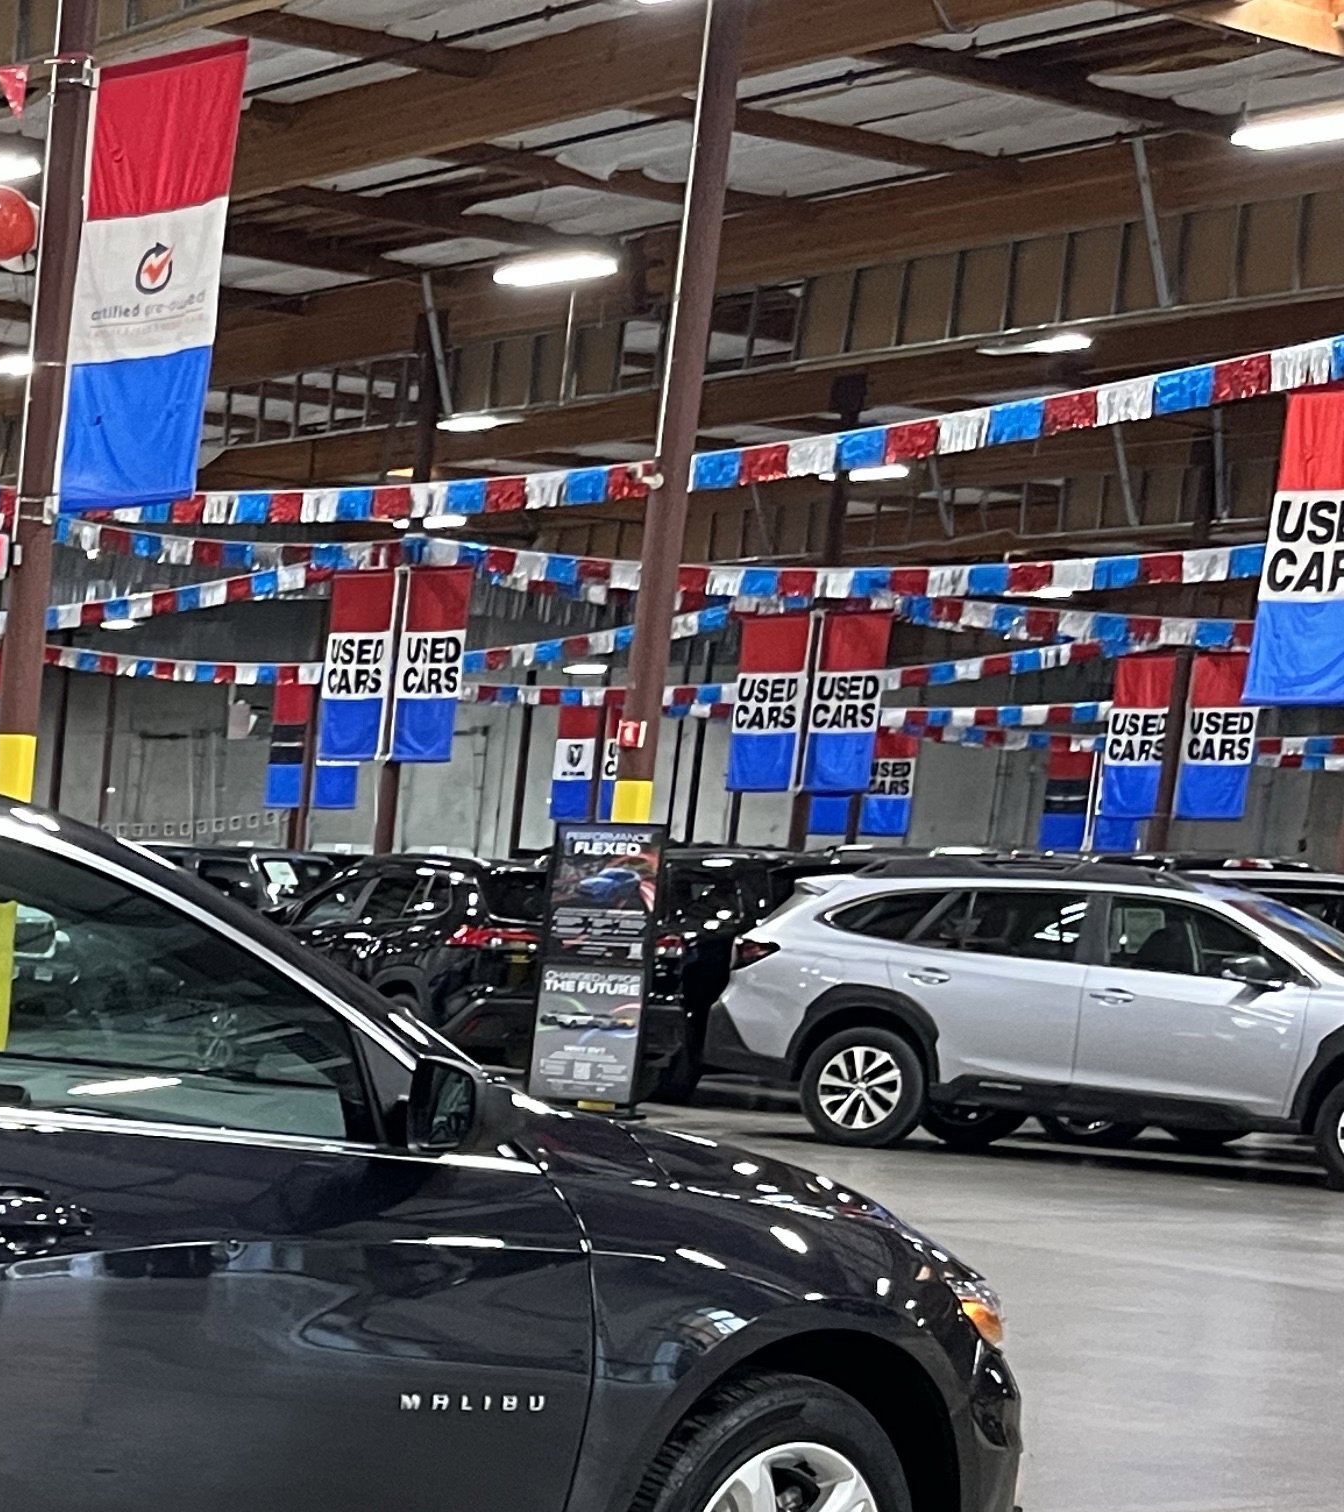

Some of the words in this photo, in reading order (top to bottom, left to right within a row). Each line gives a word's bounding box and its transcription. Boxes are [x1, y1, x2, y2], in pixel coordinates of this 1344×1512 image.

[1277, 501, 1344, 545] US
[1267, 548, 1344, 592] CA
[328, 667, 382, 694] CARS
[738, 678, 798, 703] USED
[817, 675, 879, 701] USED
[735, 704, 796, 729] CARS
[813, 703, 876, 728] CARS
[1190, 712, 1253, 735] USED
[1188, 737, 1250, 760] CARS
[574, 841, 640, 856] FLEXED
[544, 979, 576, 993] THE
[577, 980, 640, 996] FUTURE
[400, 1393, 545, 1411] MALIBU
